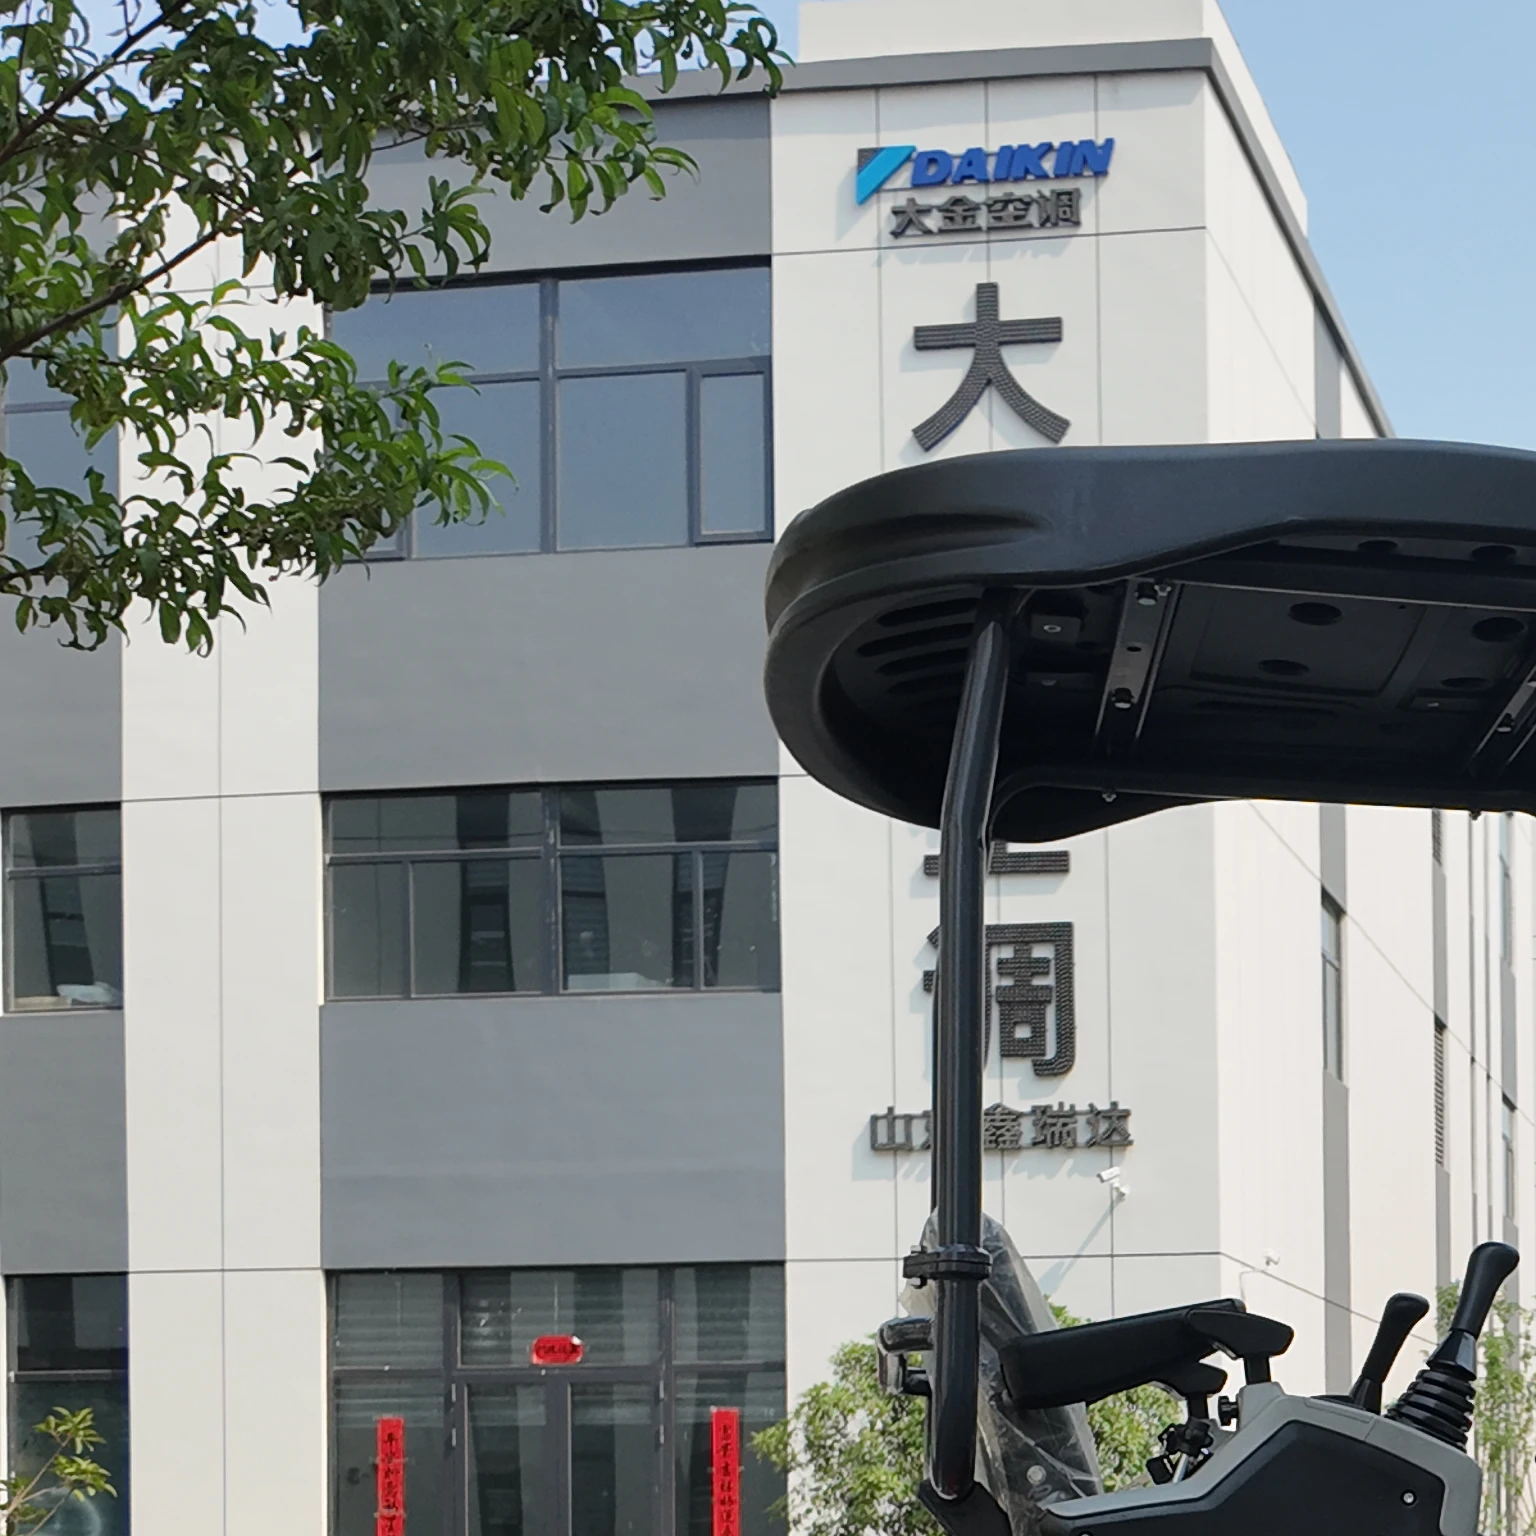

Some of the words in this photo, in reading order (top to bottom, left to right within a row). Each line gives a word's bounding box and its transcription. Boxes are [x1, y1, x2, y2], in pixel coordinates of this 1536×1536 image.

[911, 137, 1114, 187] DAIKIN
[890, 187, 1082, 238] 大金空调
[870, 1101, 1134, 1151] 山鑫瑞达
